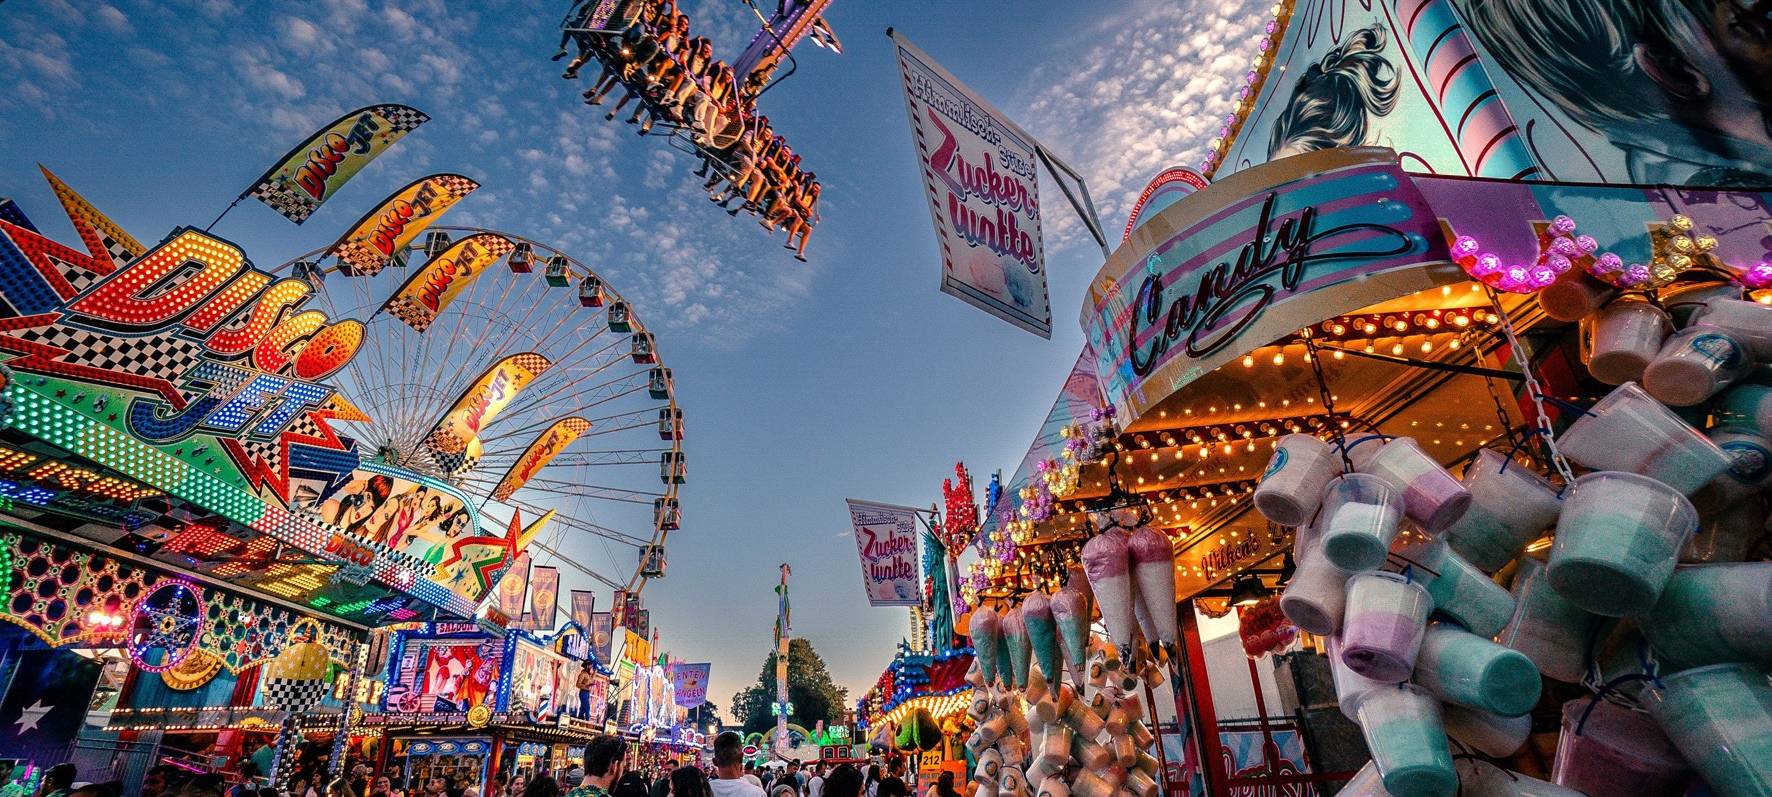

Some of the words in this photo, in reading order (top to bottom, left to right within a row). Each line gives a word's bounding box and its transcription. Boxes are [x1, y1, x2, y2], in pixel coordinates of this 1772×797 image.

[911, 69, 1002, 147] Himmlisch-
[292, 131, 351, 202] DISCO
[346, 111, 380, 155] JET
[927, 104, 1040, 221] Zucker-
[367, 199, 414, 258] DISCO
[409, 181, 439, 218] JET
[947, 191, 1040, 275] watte
[415, 258, 457, 313] DISCO
[454, 241, 479, 277] JET
[1128, 190, 1413, 378] Candy
[126, 360, 333, 443] JET
[462, 385, 493, 434] DISCO
[490, 367, 511, 401] JET
[543, 430, 561, 456] JET
[323, 531, 376, 567] DISCO
[862, 526, 914, 565] Zucker-
[870, 555, 914, 584] watte
[1202, 527, 1261, 582] Wilken's
[676, 670, 706, 681] ENTEN
[676, 687, 706, 699] ANGELN
[922, 755, 940, 766] 212
